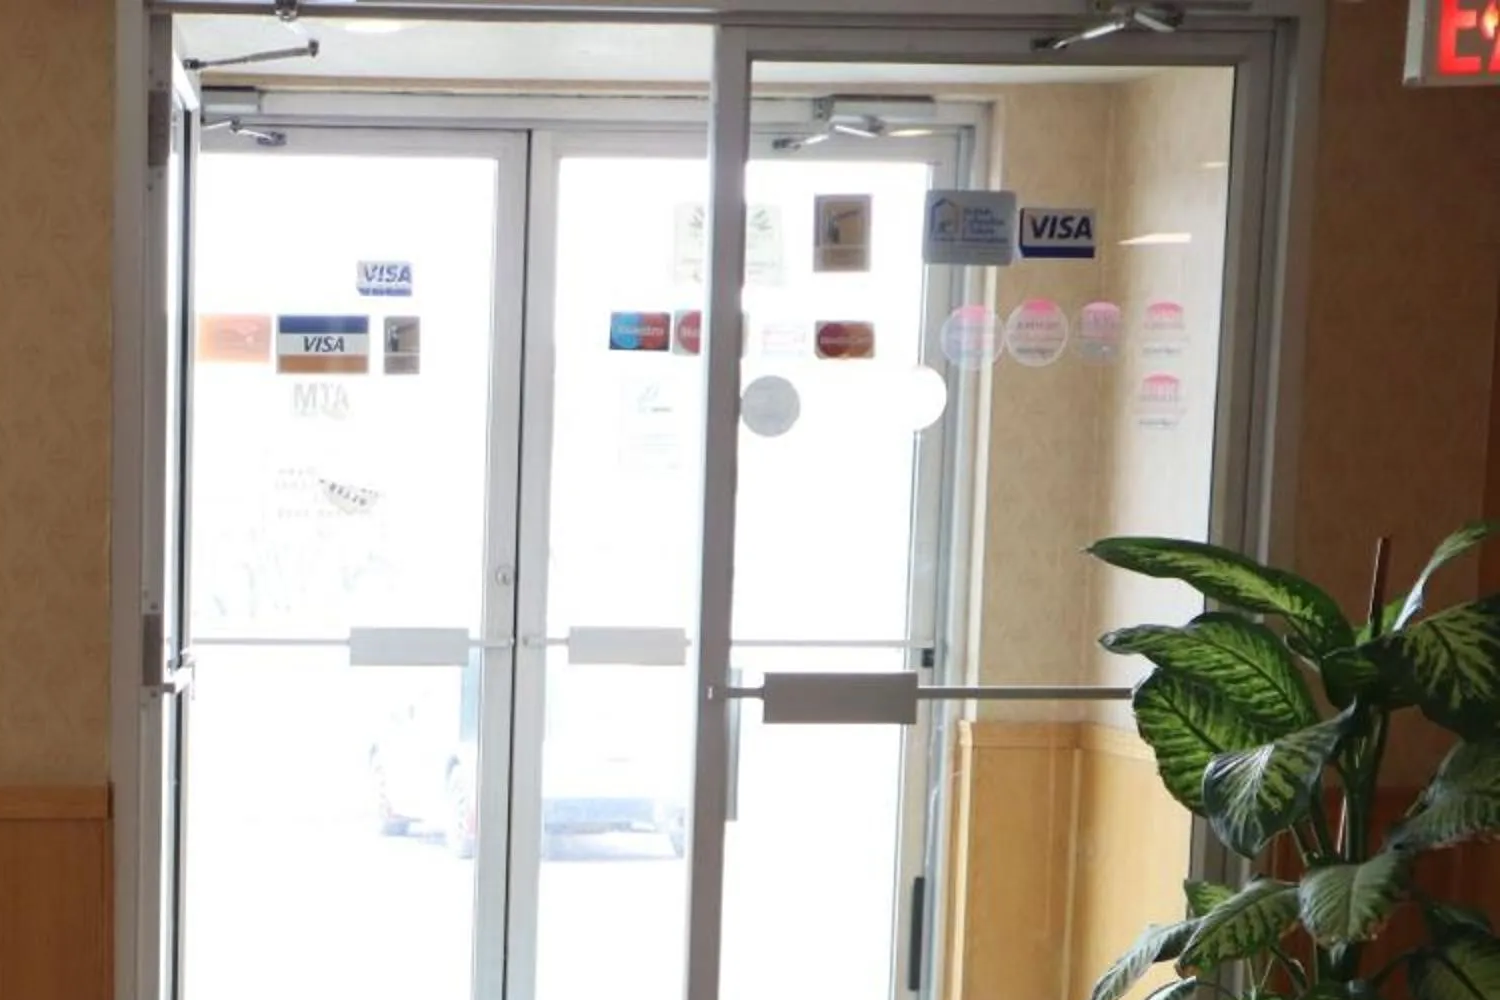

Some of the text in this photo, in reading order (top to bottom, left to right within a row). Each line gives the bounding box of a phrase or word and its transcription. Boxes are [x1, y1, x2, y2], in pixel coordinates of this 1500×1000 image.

[1030, 215, 1093, 240] VISA
[364, 265, 412, 283] VISA
[303, 335, 345, 353] VISA
